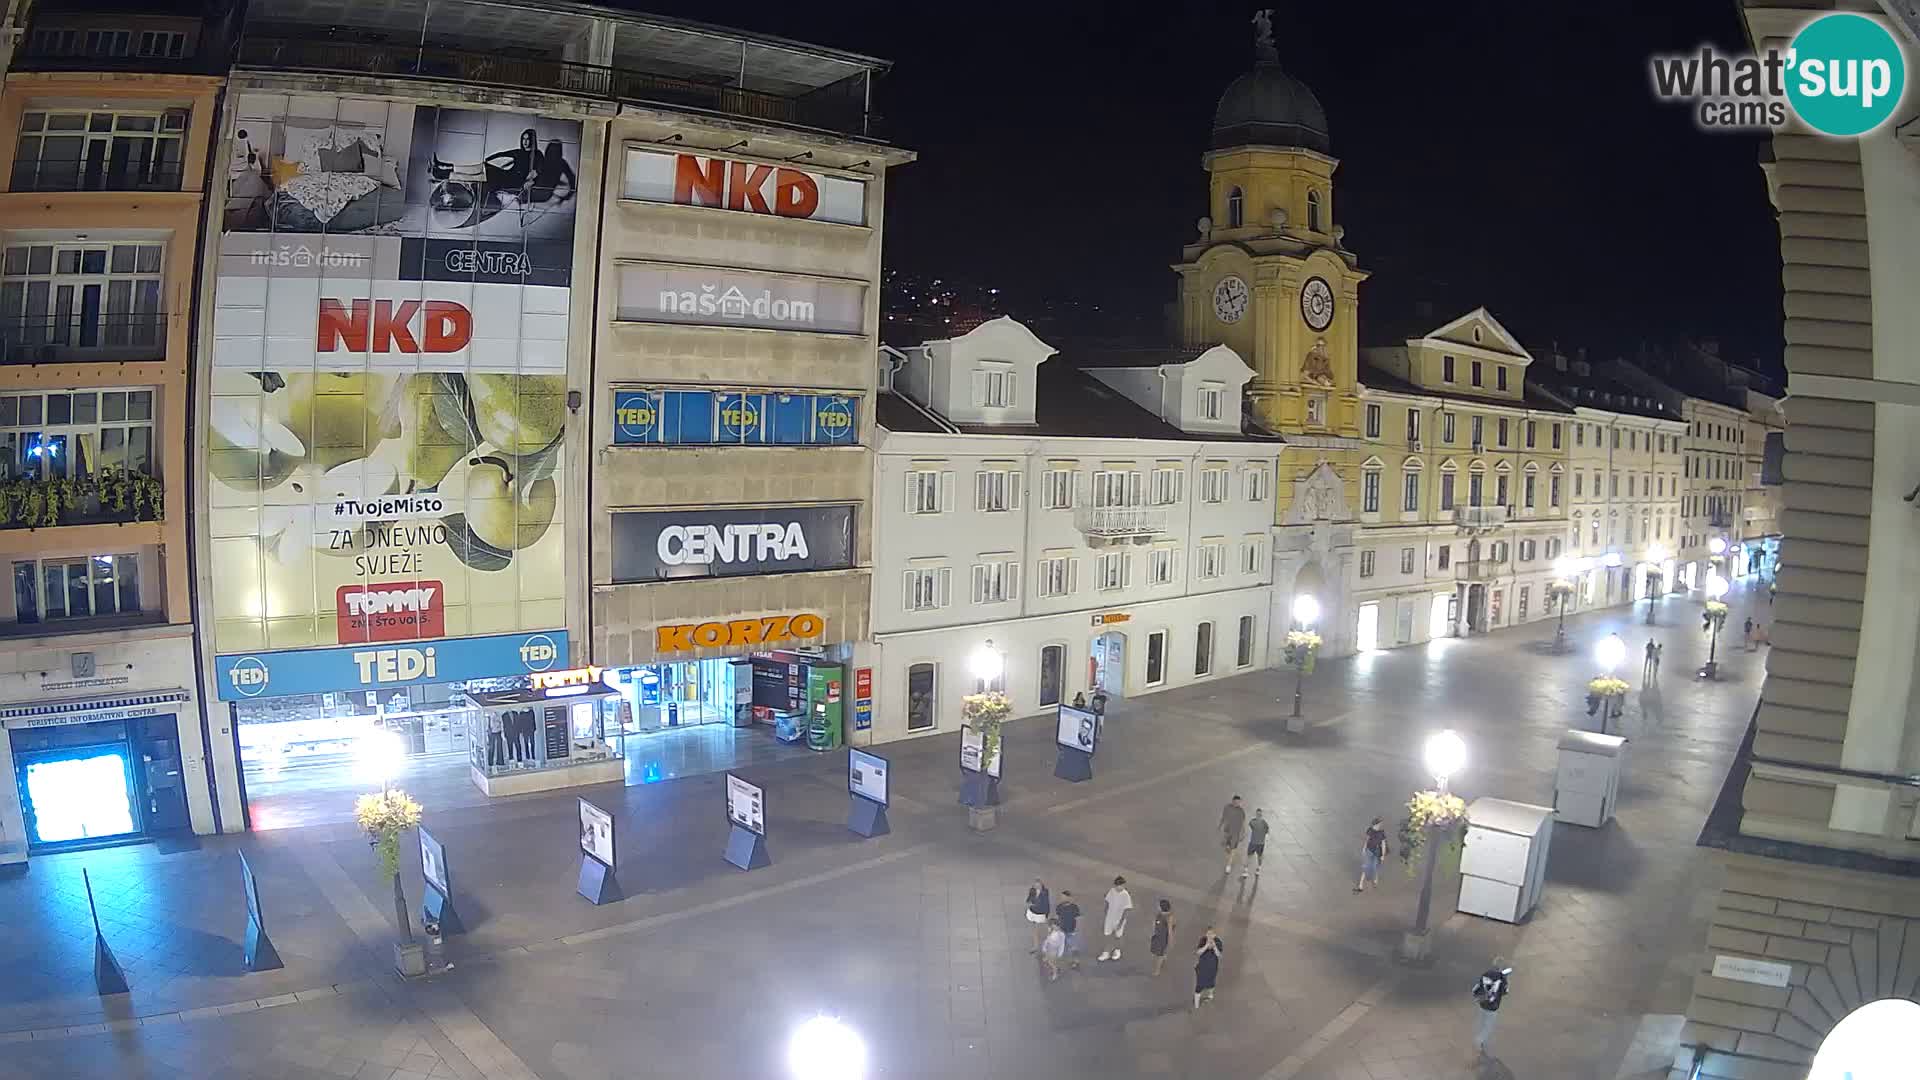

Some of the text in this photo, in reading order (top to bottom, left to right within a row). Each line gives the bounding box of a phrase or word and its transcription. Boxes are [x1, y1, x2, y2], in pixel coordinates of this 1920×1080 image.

[673, 153, 820, 219] NKD
[250, 244, 361, 268] naš dom
[445, 249, 533, 276] CENTRA
[659, 282, 815, 324] naš dom
[317, 297, 474, 354] NKD
[616, 408, 657, 426] TEDi
[721, 409, 758, 426] TEDi
[817, 411, 852, 428] TEDi
[334, 497, 443, 517] #TvojeMisto
[329, 524, 448, 550] ZA DNEVNO
[657, 522, 809, 566] CENTRA
[355, 548, 423, 576] SVJEŽE
[344, 588, 436, 616] TOMMY
[375, 615, 397, 627] ŠTO
[656, 613, 824, 653] KORZO
[351, 646, 437, 685] TEDi
[519, 643, 558, 663] TEDi
[229, 666, 269, 687] TEDi
